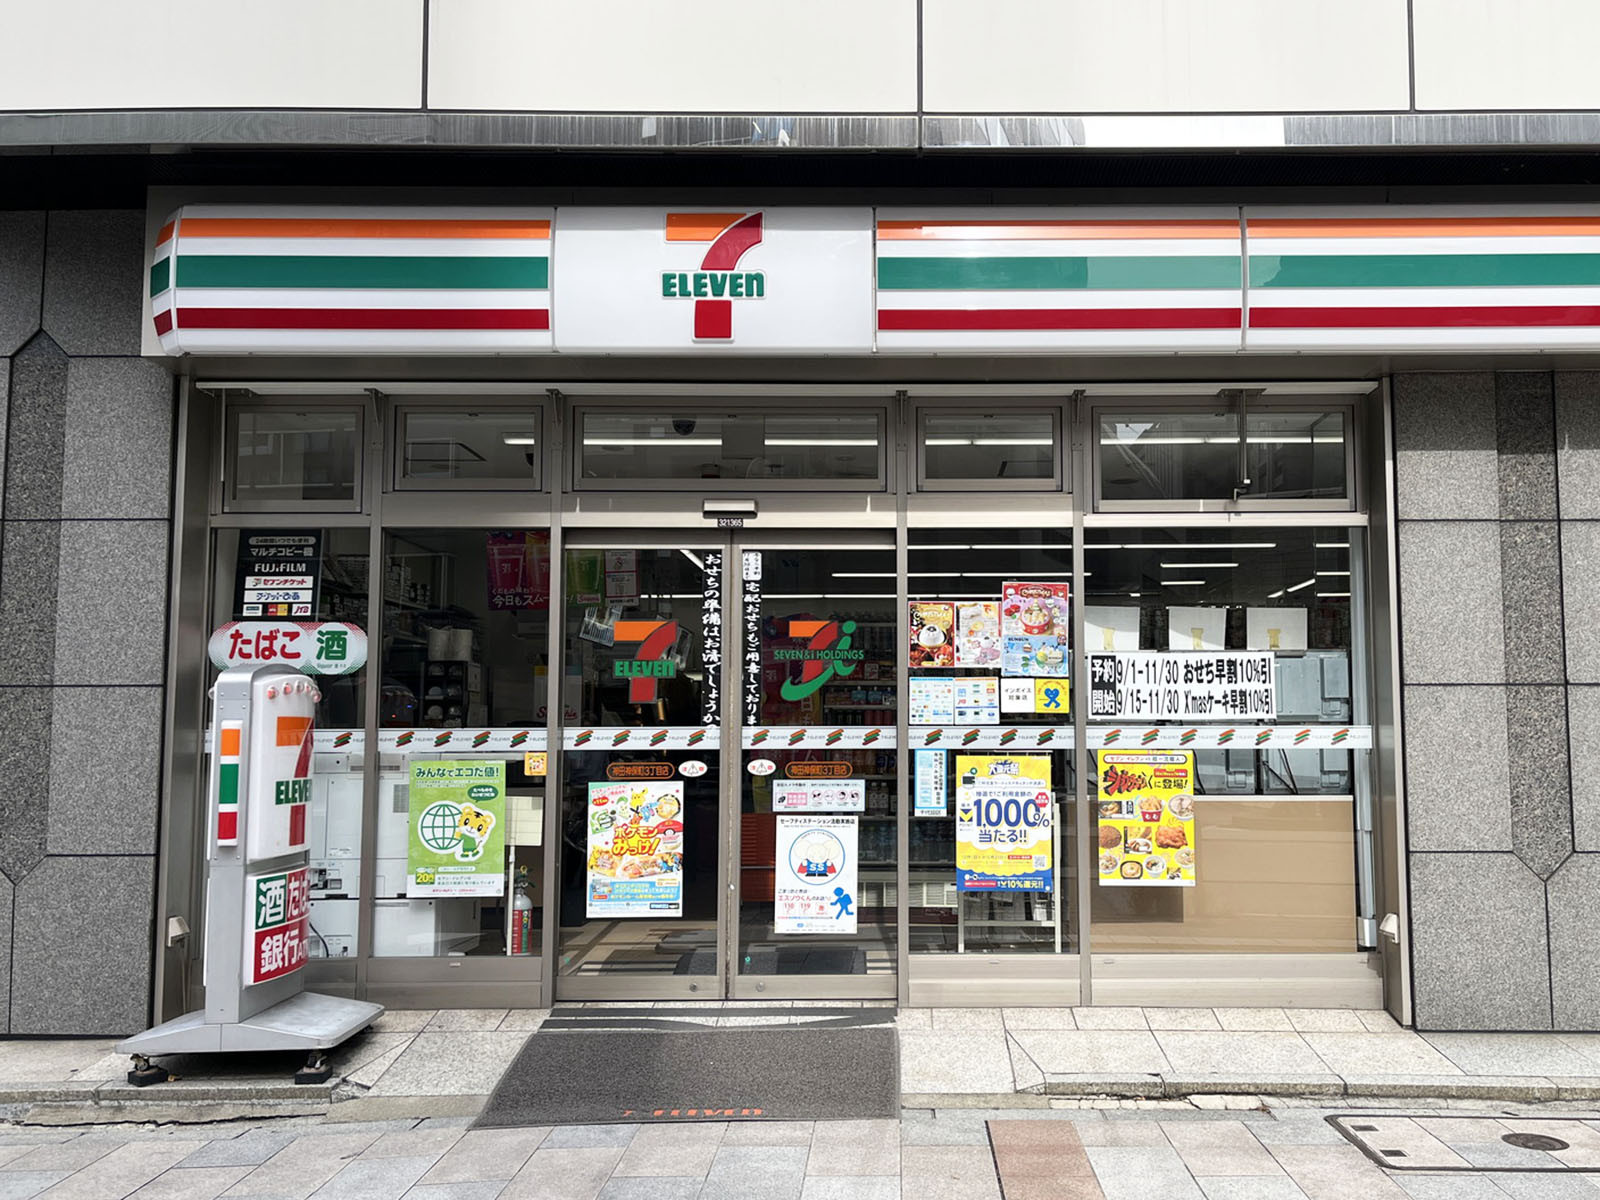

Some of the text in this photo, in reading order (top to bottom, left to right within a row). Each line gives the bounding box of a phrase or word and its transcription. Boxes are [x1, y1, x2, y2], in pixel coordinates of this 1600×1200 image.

[666, 212, 763, 342] 7
[228, 629, 348, 661] たばこ 酒
[702, 553, 722, 729] おせちの準備はお済でしょうか
[743, 582, 762, 726] 宅配おせちもご用意しておりま
[614, 620, 677, 703] 7
[816, 650, 864, 660] HOLDINGS
[1092, 658, 1271, 685] 予約 9/1-11/30 おせち早割10%引
[1092, 690, 1116, 714] 開始
[1116, 688, 1179, 714] 9/15-11/30
[415, 767, 499, 778] みんなでエコだ値!
[275, 779, 312, 805] ELEVE
[615, 826, 658, 838] ポケモン
[978, 829, 1027, 843] 当たる!!
[612, 838, 661, 855] みっけ!
[809, 863, 825, 871] SS
[257, 878, 286, 928] 酒
